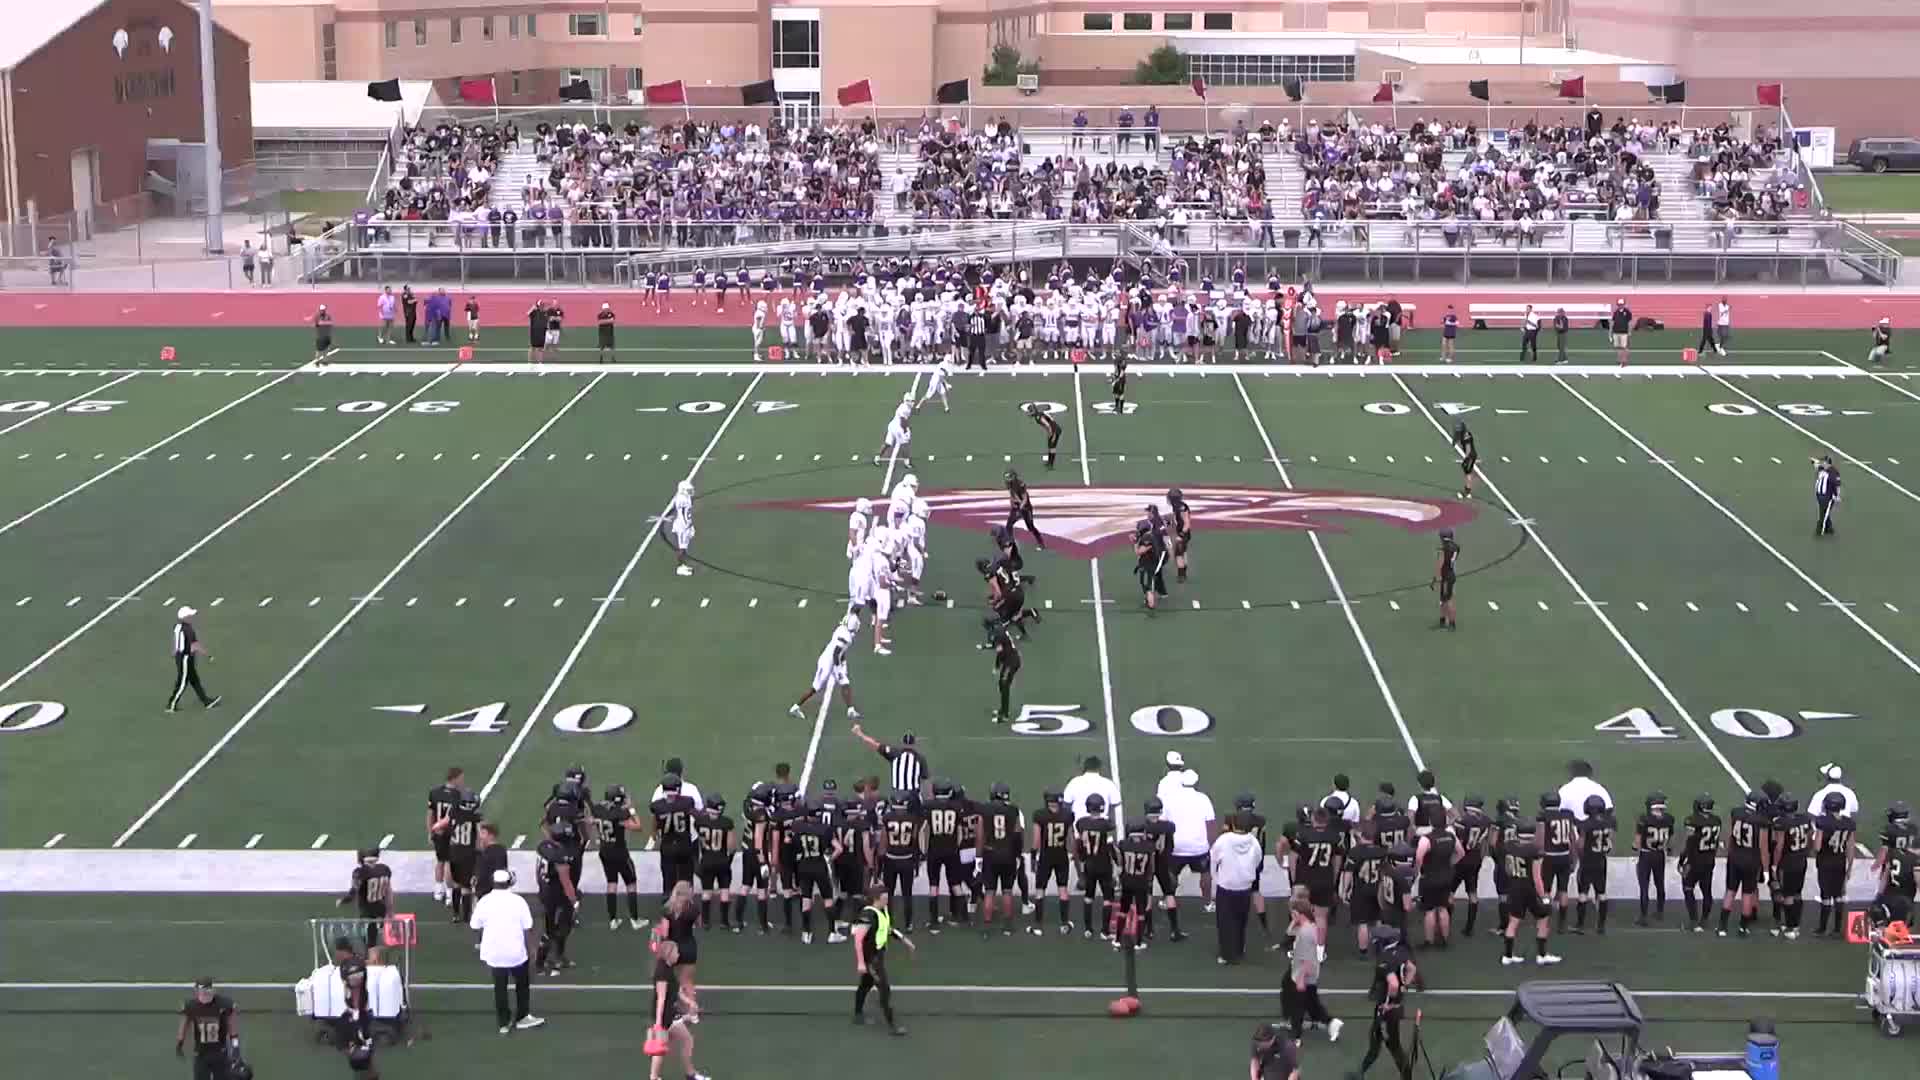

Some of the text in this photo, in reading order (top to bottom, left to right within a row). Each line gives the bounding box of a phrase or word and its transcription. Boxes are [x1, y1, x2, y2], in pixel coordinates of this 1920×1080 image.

[887, 821, 913, 846] 26
[931, 809, 956, 835] 88
[993, 814, 1007, 840] 8
[1047, 822, 1065, 848] 12
[1550, 819, 1570, 845] 30
[1732, 819, 1753, 848] 43
[1308, 842, 1332, 867] 73
